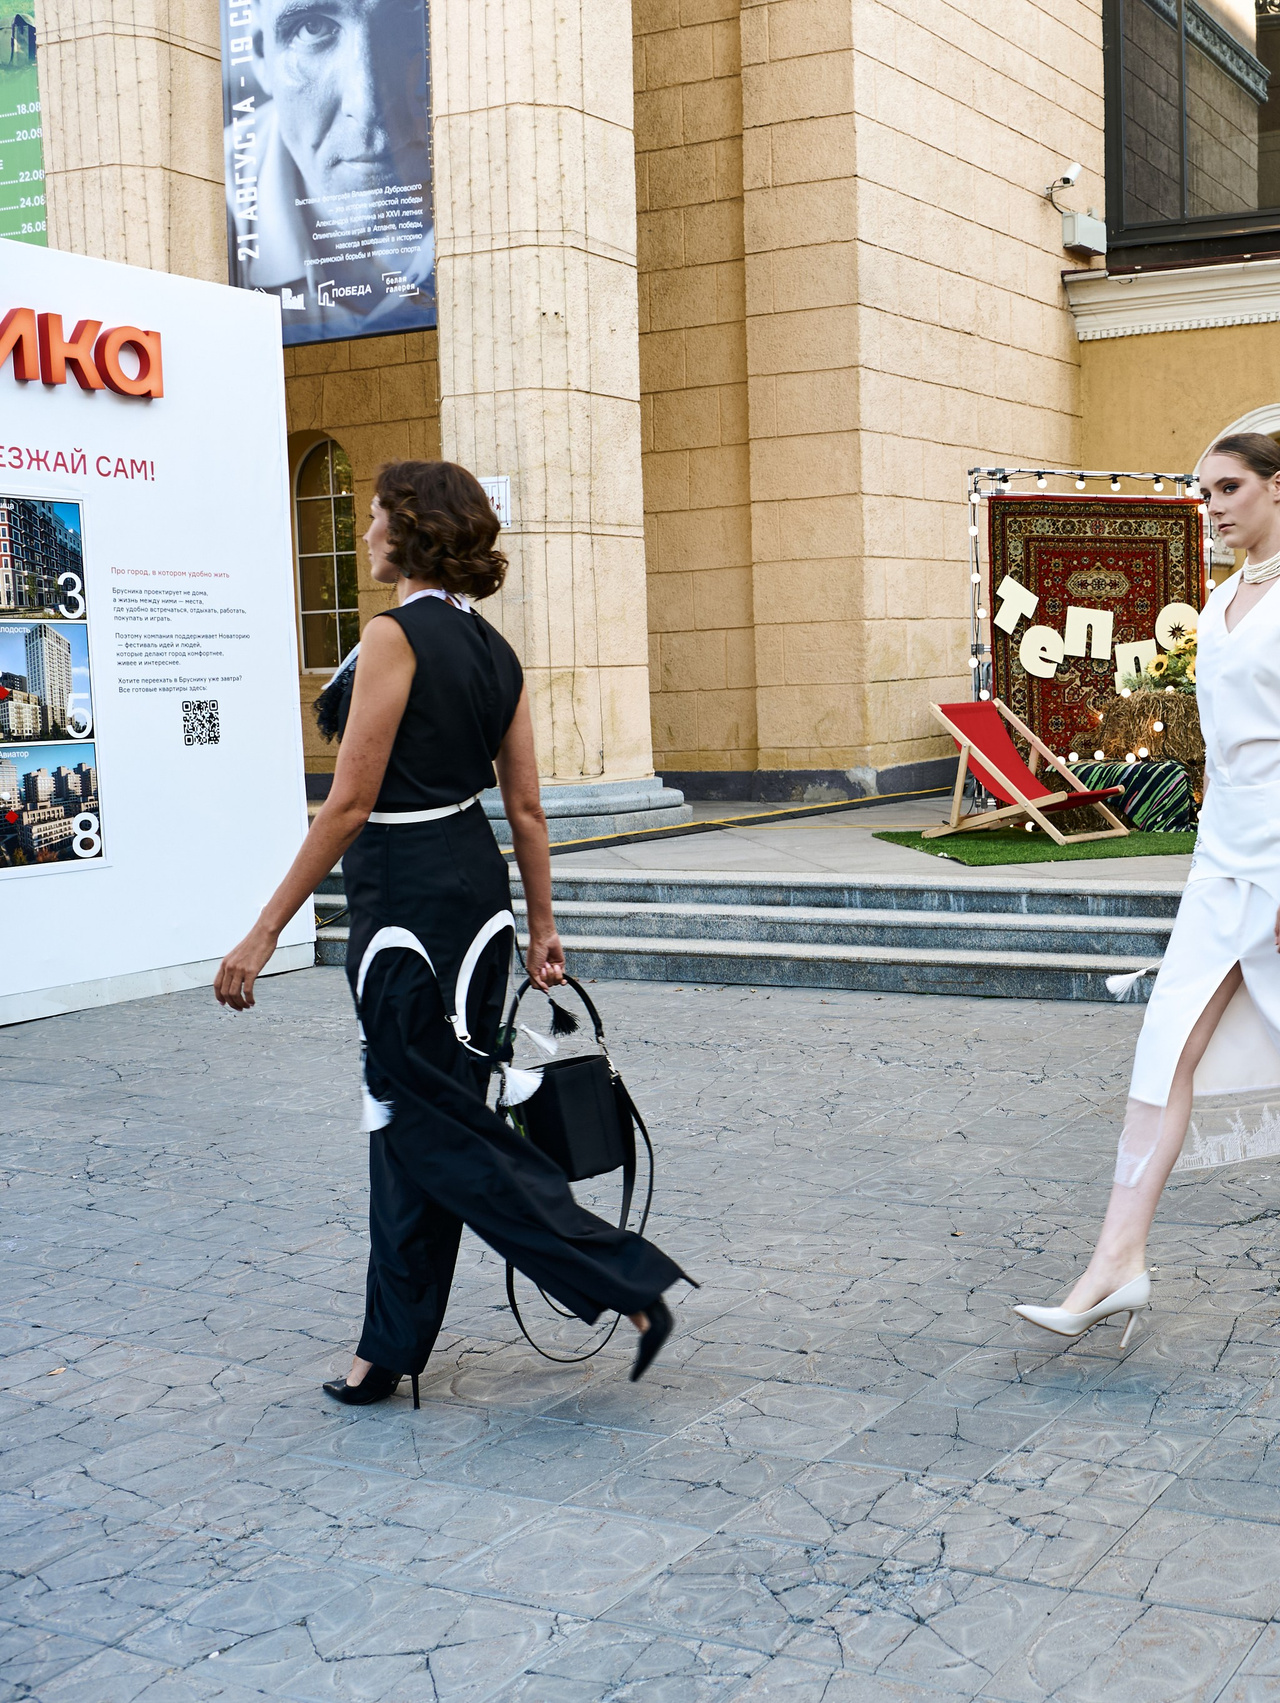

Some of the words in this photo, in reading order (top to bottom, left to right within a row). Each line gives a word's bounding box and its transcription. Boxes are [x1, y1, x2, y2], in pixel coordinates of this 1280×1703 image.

[231, 36, 253, 66] 19
[17, 102, 41, 114] 18.08
[233, 95, 259, 221] АВГУСТА
[352, 188, 382, 198] Владимира
[385, 183, 422, 195] Дубровского
[369, 198, 398, 208] непростой
[401, 197, 422, 205] победы
[313, 230, 350, 240] Олимпийских
[399, 221, 423, 229] победы,
[238, 233, 259, 261] 21
[335, 240, 360, 249] навсегда
[361, 236, 389, 247] вошедшей
[397, 233, 422, 242] историю
[304, 254, 344, 266] греко-римской
[346, 251, 366, 261] борьбы
[372, 248, 399, 257] мирового
[386, 276, 407, 285] белая
[386, 283, 415, 293] галерея
[332, 284, 372, 297] ПОБЕДА
[96, 455, 155, 481] САМ!
[111, 567, 125, 575] Про
[127, 568, 150, 576] город,
[158, 570, 186, 578] котором
[57, 572, 85, 619] 3
[112, 587, 142, 595] Брусника
[179, 676, 206, 684] Бруснику
[66, 693, 92, 738] 5
[72, 812, 101, 858] 8
